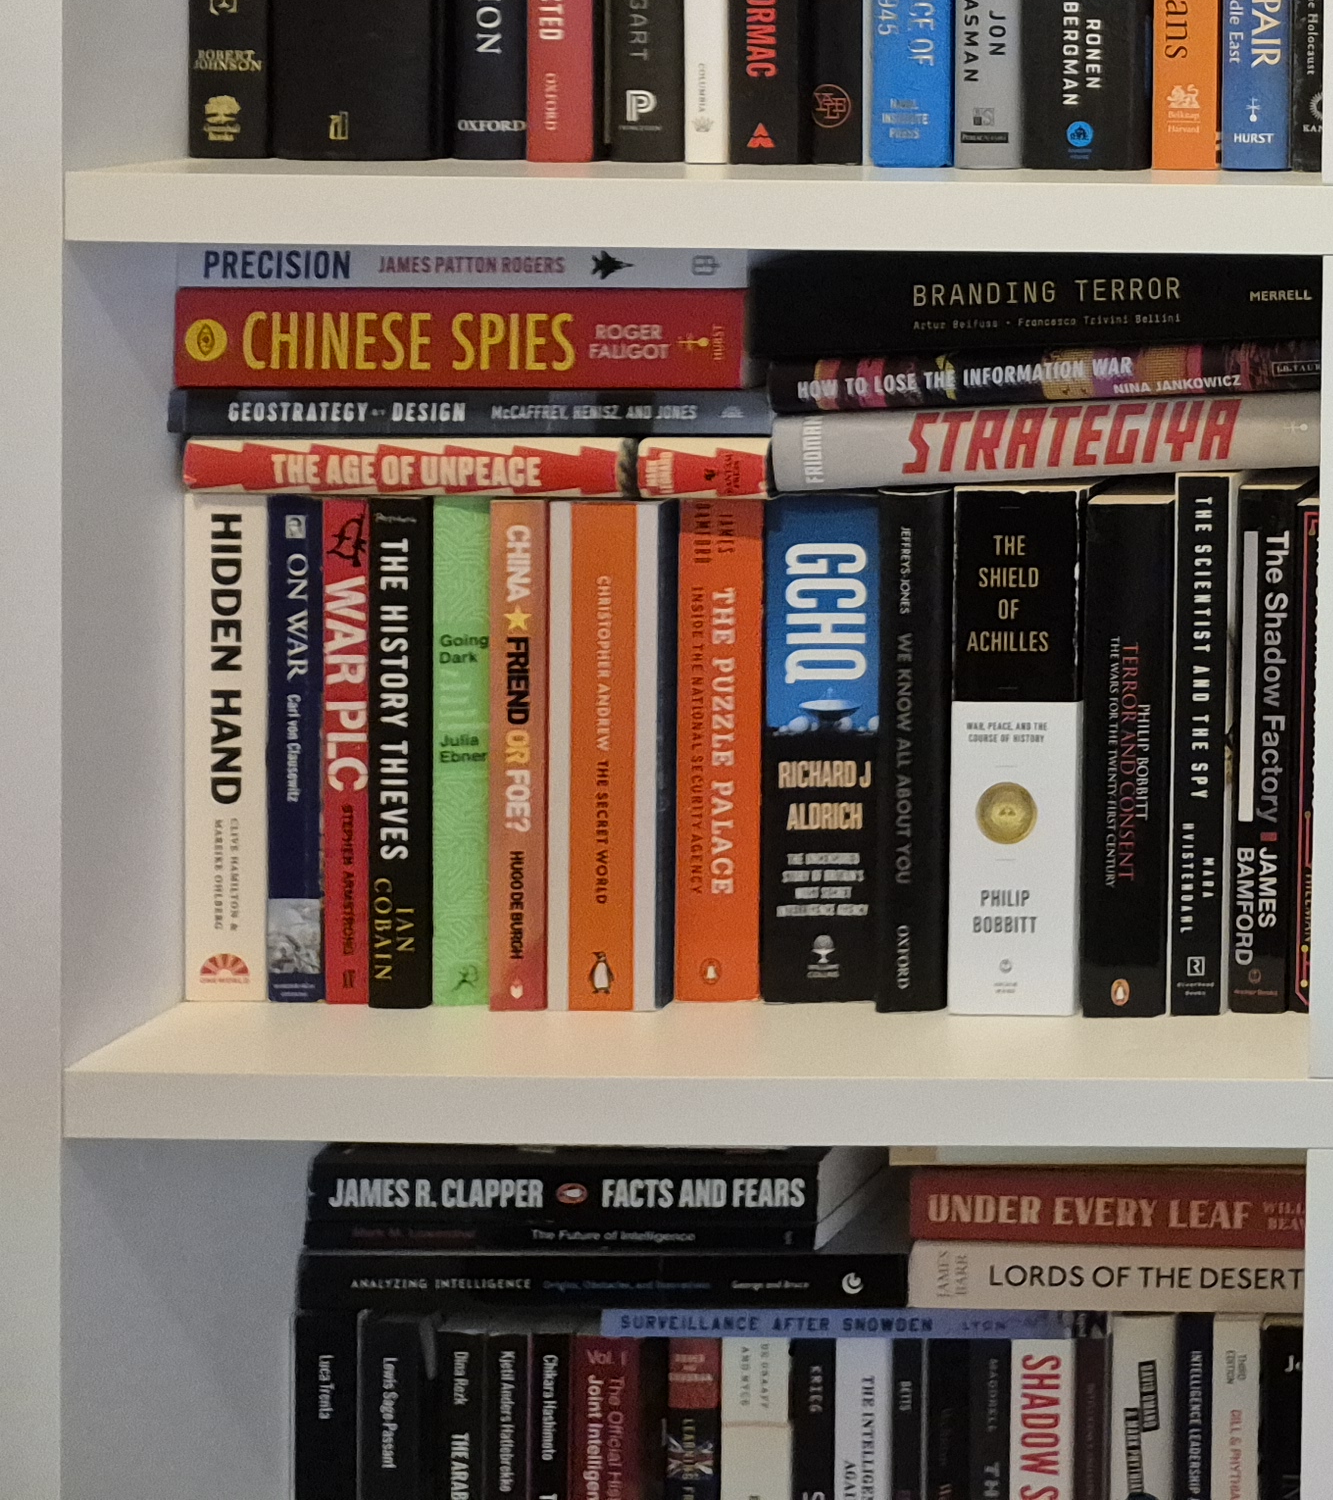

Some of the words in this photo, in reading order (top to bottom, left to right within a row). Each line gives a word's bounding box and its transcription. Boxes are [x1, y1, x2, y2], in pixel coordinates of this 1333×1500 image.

[204, 250, 350, 279] PRECISION
[913, 281, 1055, 306] BRANDING
[1075, 277, 1179, 301] TERROR
[243, 312, 431, 370] CHINESE
[452, 313, 575, 371] SPIES
[994, 535, 1025, 555] THE
[979, 567, 1039, 587] SHIELD
[998, 599, 1019, 619] OF
[967, 631, 1048, 652] ACHILLES
[981, 890, 1030, 907] PHILIP
[973, 916, 1037, 933] BOBBITT
[329, 1179, 410, 1207] JAMES
[415, 1179, 437, 1207] R.
[442, 1179, 543, 1208] CLAPPER
[602, 1179, 673, 1208] FACTS
[679, 1179, 727, 1208] AND
[732, 1178, 805, 1207] FEARS
[929, 1195, 1041, 1224] UNDER
[1053, 1197, 1155, 1227] EVERY
[1169, 1200, 1251, 1229] LEAF
